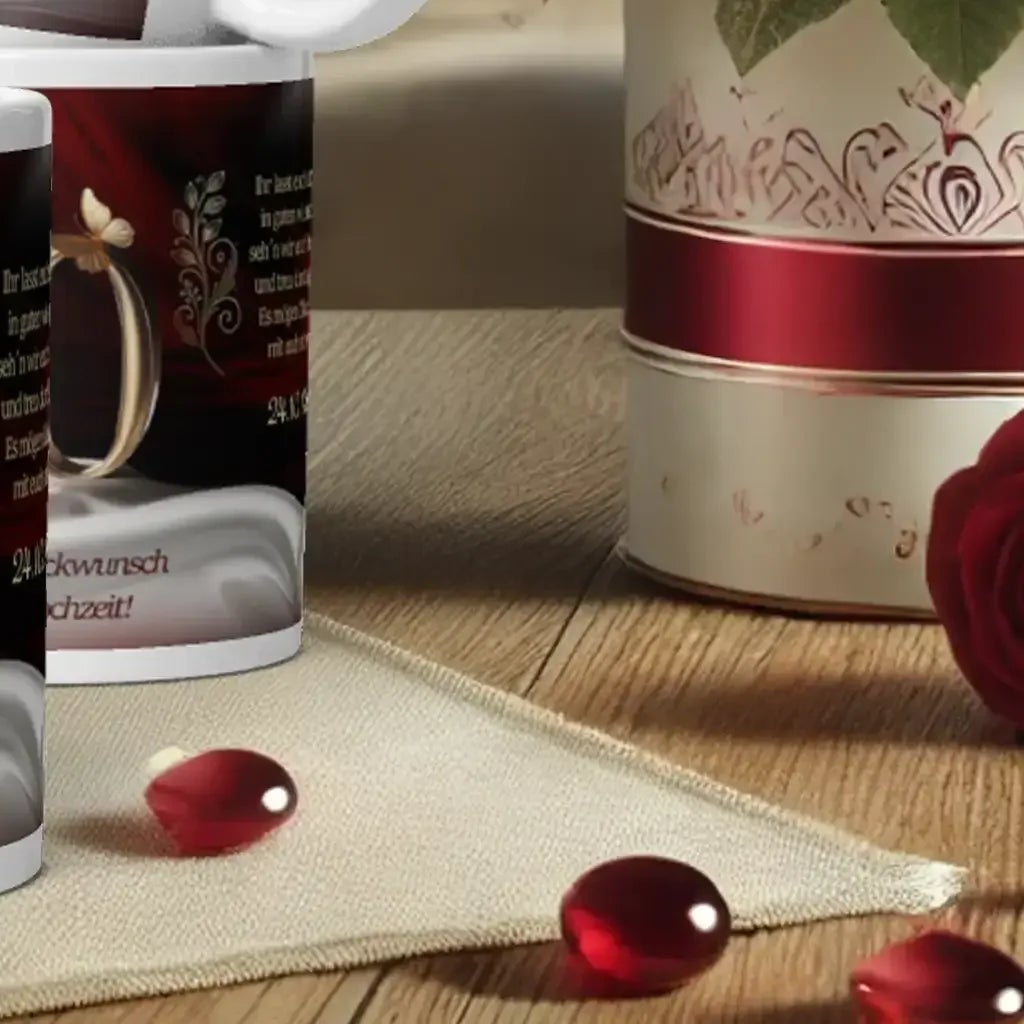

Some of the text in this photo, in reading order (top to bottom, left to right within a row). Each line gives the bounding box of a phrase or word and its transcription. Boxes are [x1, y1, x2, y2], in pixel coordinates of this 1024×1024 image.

[2, 268, 19, 295] Ihr
[8, 309, 19, 336] in
[1, 390, 22, 420] und
[5, 436, 18, 461] Es
[13, 473, 29, 500] mit
[46, 548, 169, 577] ckwunsch
[46, 594, 134, 621] chzeit!
